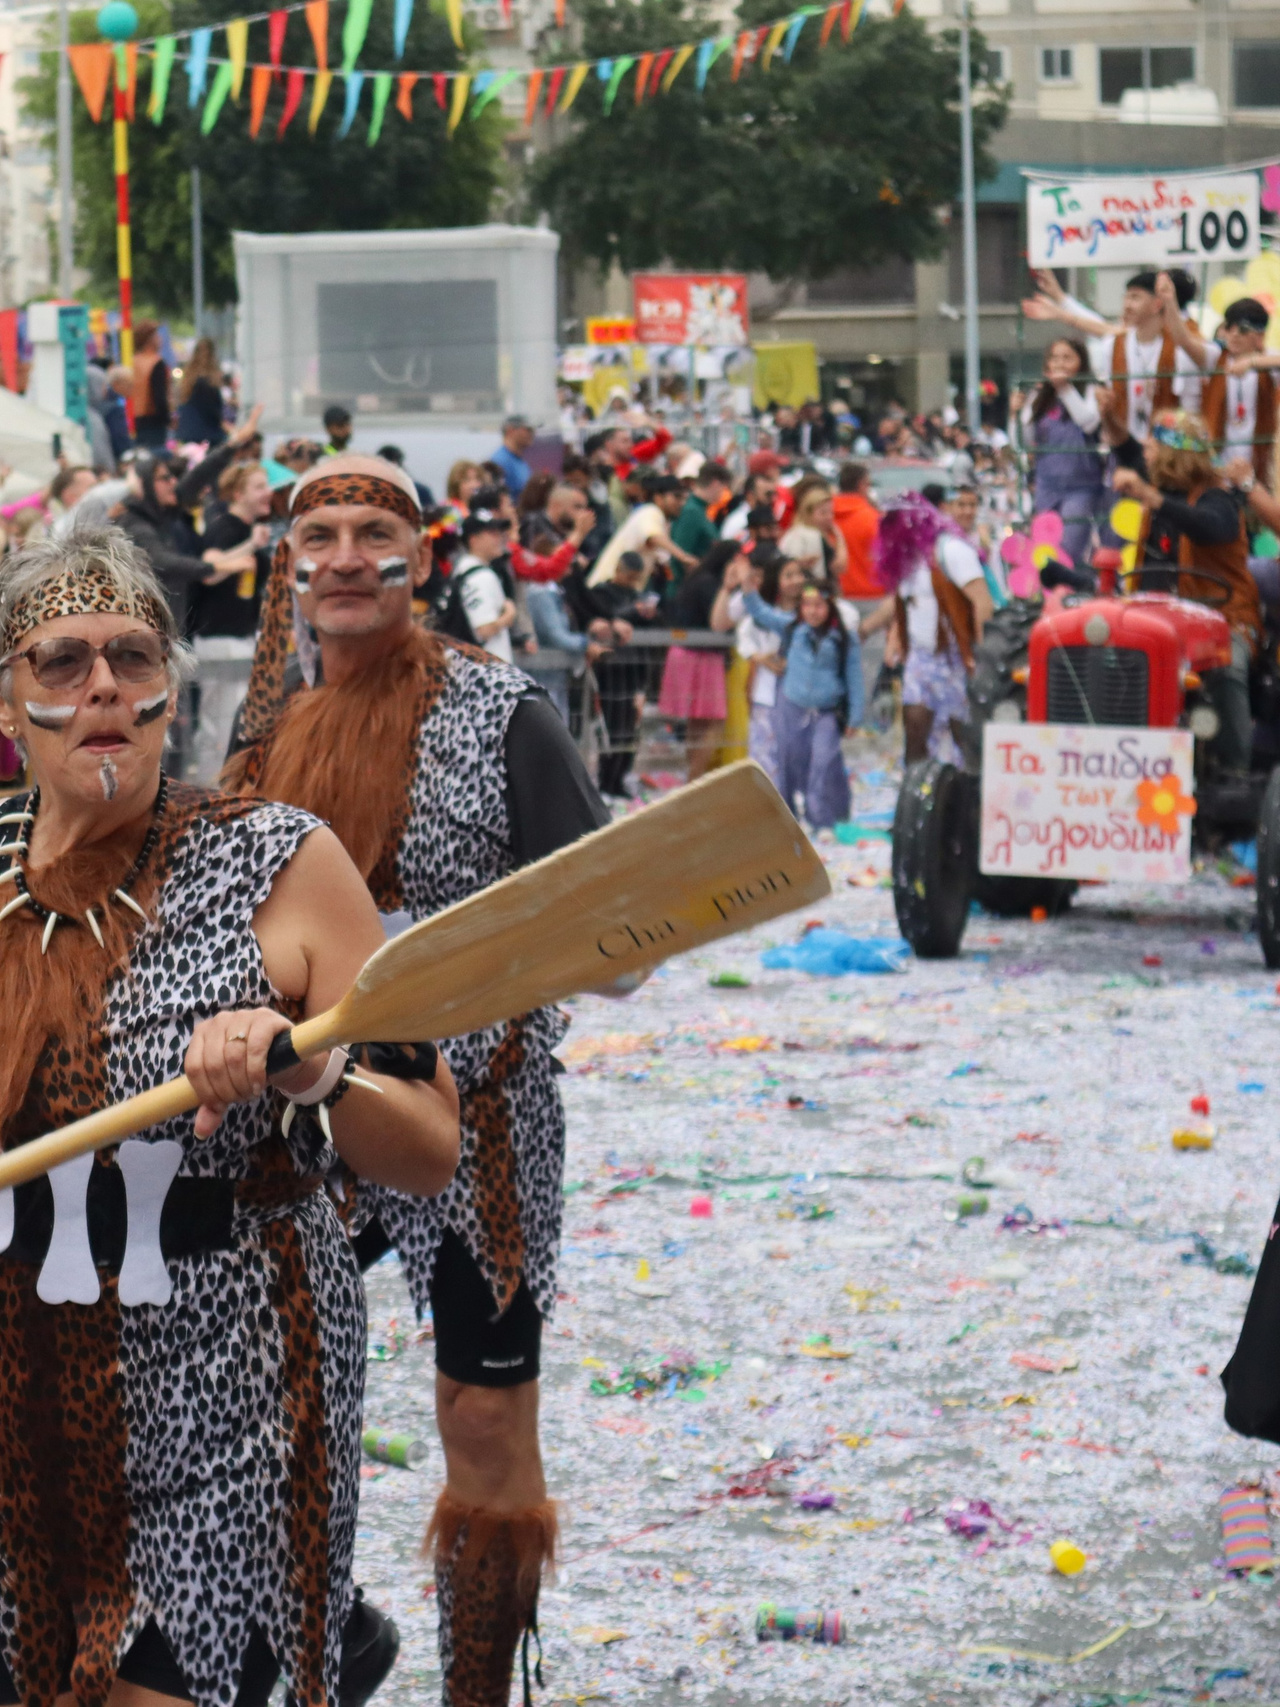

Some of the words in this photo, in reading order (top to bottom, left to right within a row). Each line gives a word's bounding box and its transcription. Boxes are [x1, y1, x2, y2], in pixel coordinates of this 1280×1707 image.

[1041, 186, 1081, 216] Τα
[1167, 209, 1248, 255] 100
[995, 741, 1045, 775] Τα
[1057, 736, 1173, 779] παιδια
[1056, 784, 1116, 807] των
[596, 868, 793, 960] Chapion
